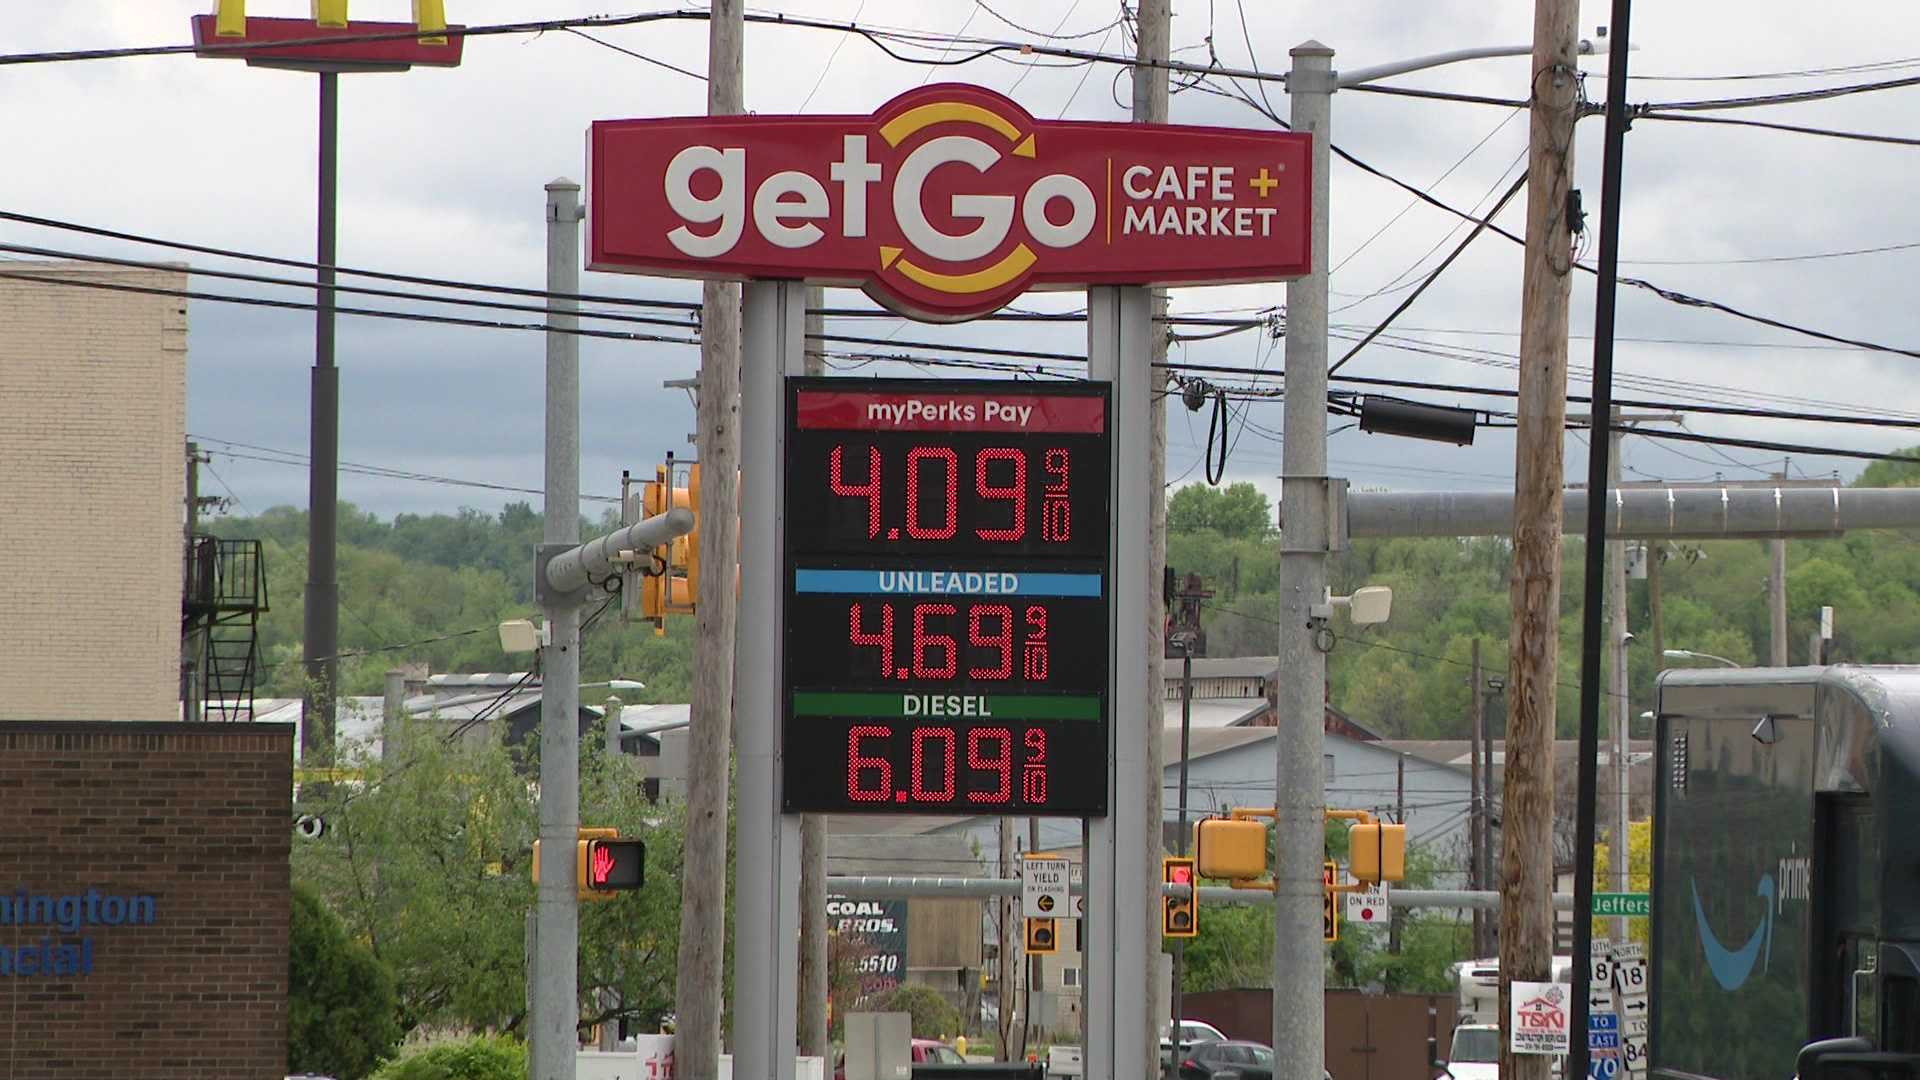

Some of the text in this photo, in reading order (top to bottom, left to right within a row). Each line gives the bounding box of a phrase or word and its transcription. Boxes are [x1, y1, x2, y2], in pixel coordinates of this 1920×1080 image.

[1122, 165, 1235, 201] CAFE
[664, 134, 1097, 262] getGo
[1122, 205, 1278, 237] MARKET
[867, 400, 1033, 427] myPerks Pay
[878, 571, 1019, 594] UNLEADED
[902, 694, 992, 717] DIESEL
[1026, 862, 1066, 871] LEFT TURN
[1033, 873, 1060, 884] YIELD
[826, 901, 884, 916] COAL
[1350, 896, 1384, 906] ON RED
[1593, 897, 1649, 913] Jeffers
[1592, 942, 1610, 951] UTH
[1595, 962, 1608, 981] 8
[1622, 966, 1643, 987] 18
[1592, 1016, 1609, 1028] TO
[1589, 1033, 1616, 1047] EAST
[1591, 1058, 1617, 1078] 70
